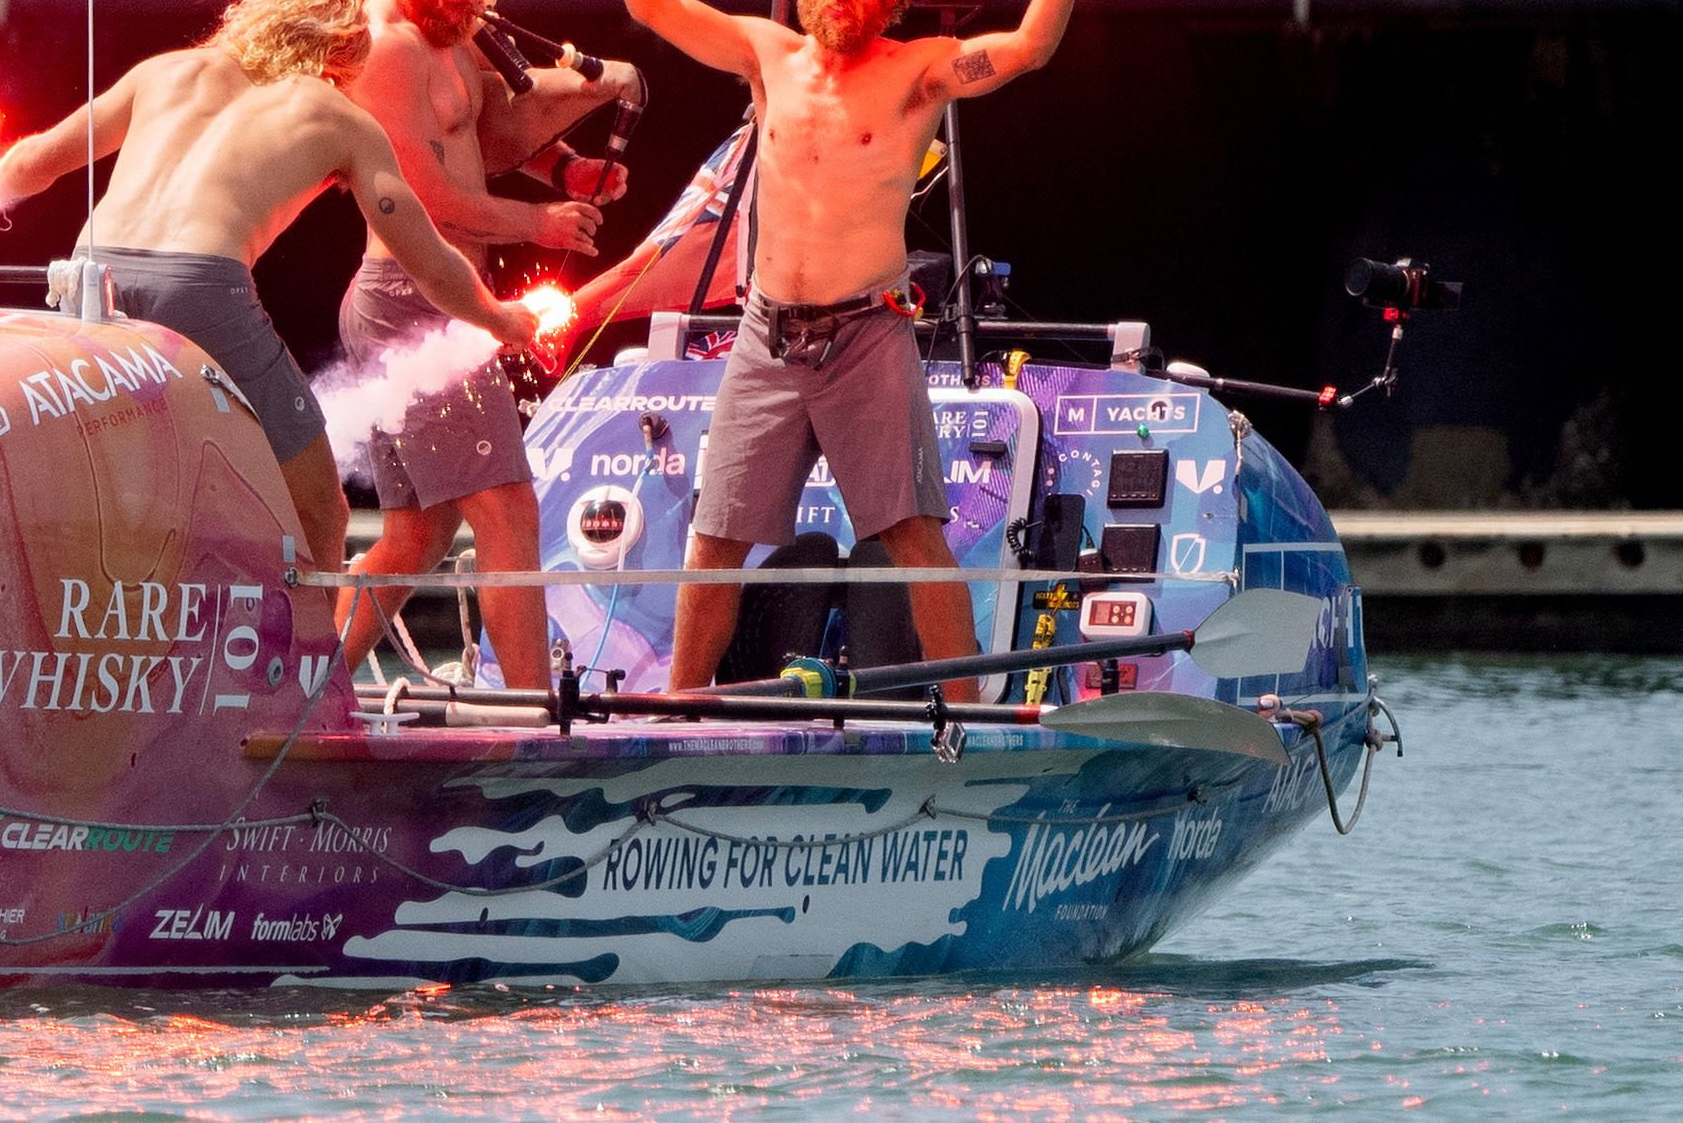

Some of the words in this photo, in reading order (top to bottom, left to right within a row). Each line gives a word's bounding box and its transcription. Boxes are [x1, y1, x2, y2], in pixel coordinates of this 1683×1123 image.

[19, 342, 184, 426] ATACAMA
[76, 397, 169, 439] PERFORMANCE
[547, 395, 717, 412] CLEARROUTE
[1067, 407, 1086, 422] M
[1106, 405, 1186, 422] YACHTS
[54, 577, 208, 642] RARE
[1, 822, 179, 855] CLEARROUTE
[225, 816, 297, 853] SWIFT
[308, 821, 393, 855] MORRIS
[218, 864, 380, 885] INTERIORS
[602, 834, 719, 892] ROWING
[724, 834, 779, 888] FOR
[784, 832, 875, 887] CLEAN
[879, 829, 969, 883] WATER
[148, 902, 235, 941] ZELIM
[250, 912, 320, 942] formlabs
[1053, 904, 1109, 921] FOUNDATION
